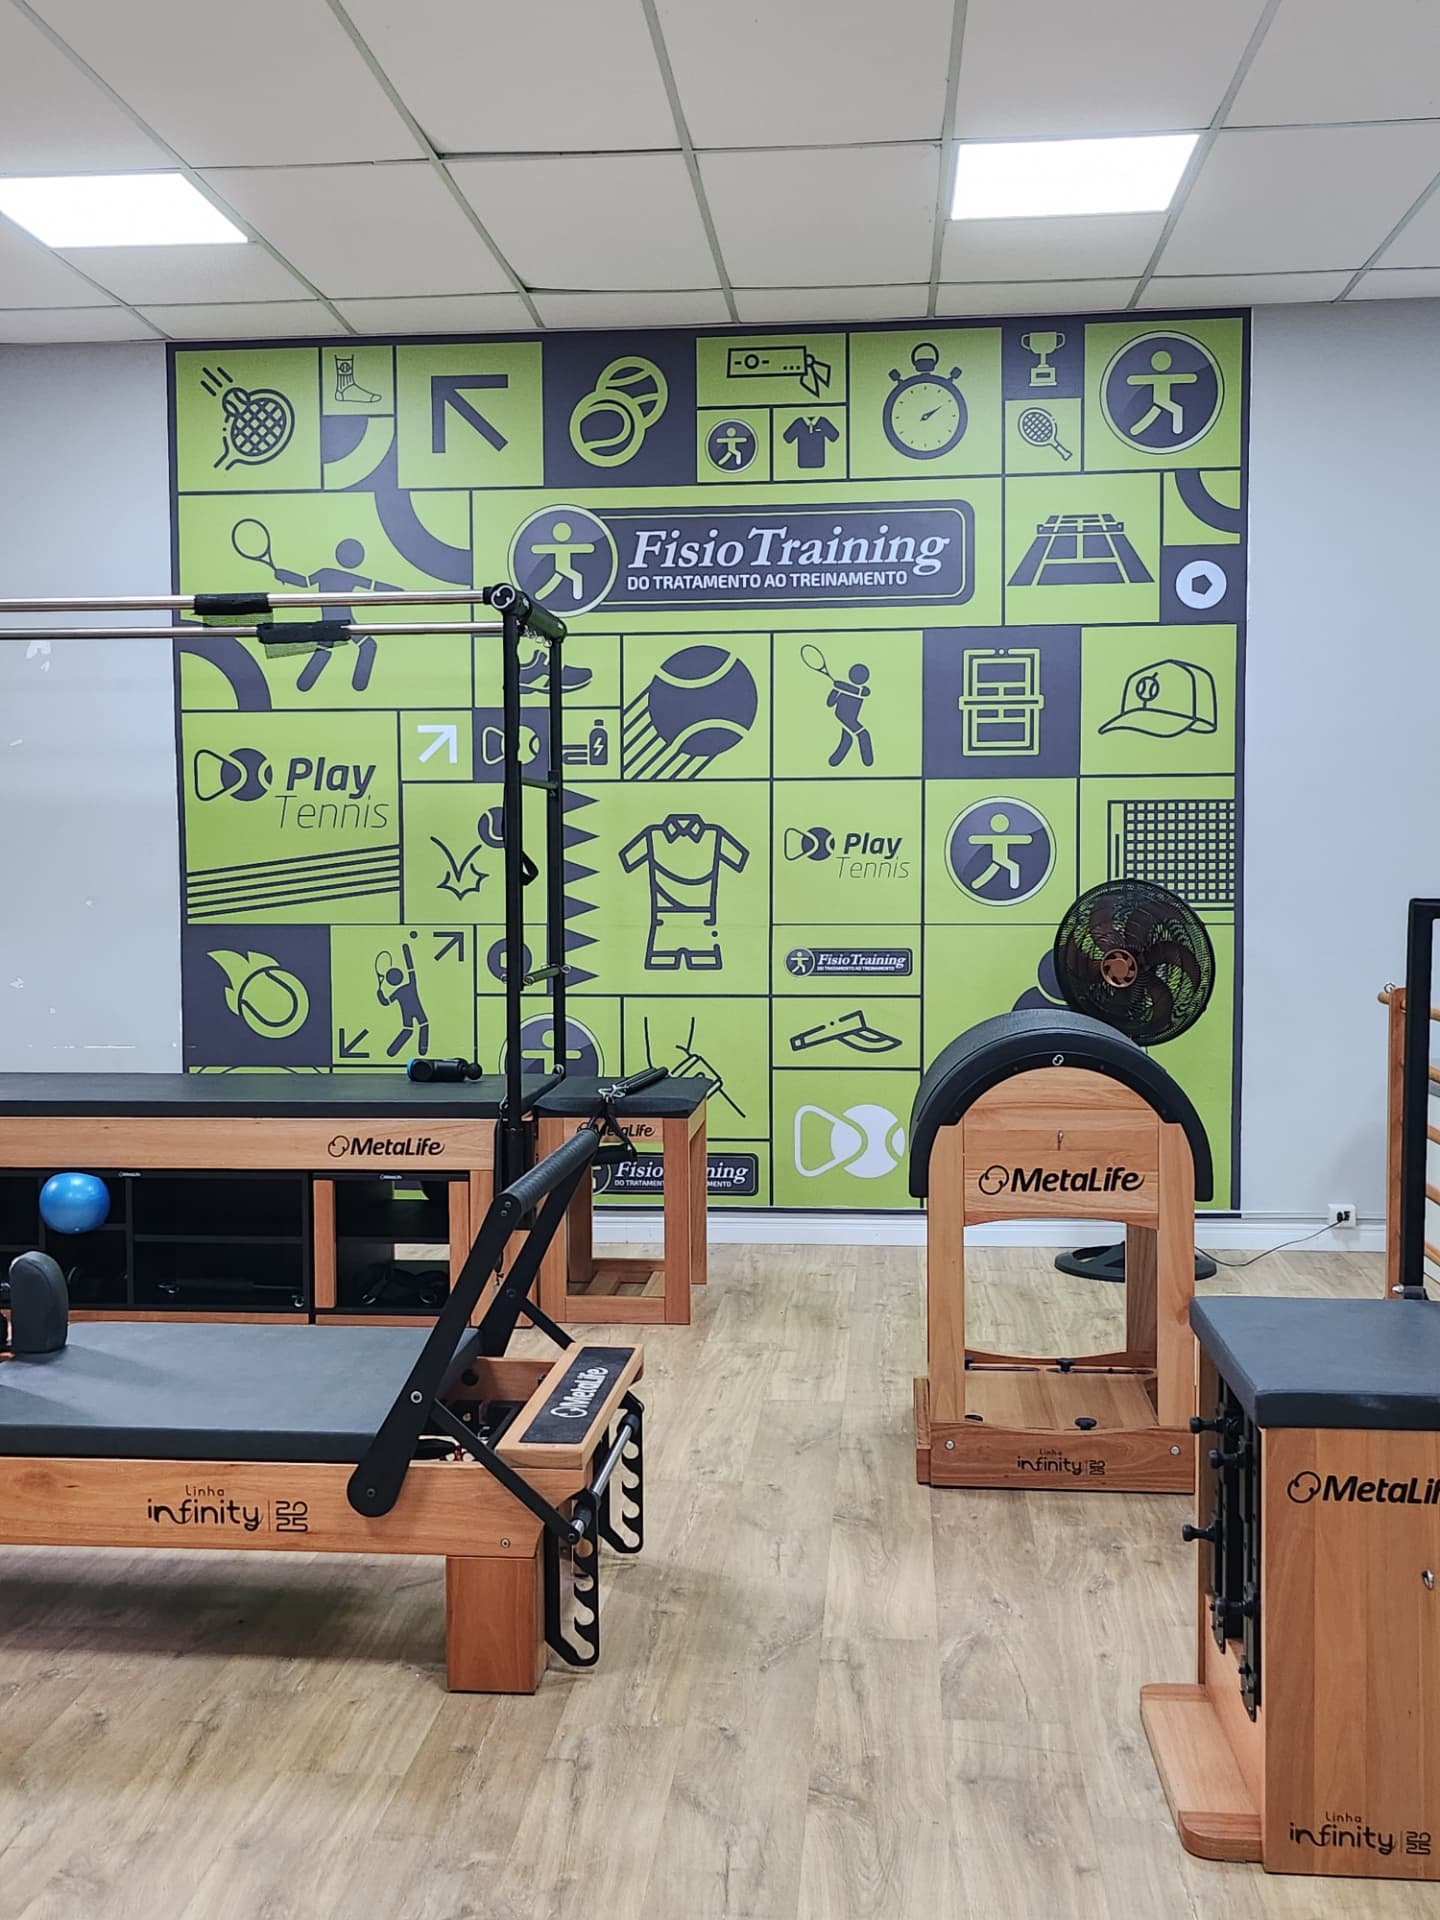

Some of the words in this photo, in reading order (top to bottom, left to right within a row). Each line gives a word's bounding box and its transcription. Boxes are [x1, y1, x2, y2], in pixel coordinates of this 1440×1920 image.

[628, 576, 649, 590] DO
[653, 573, 760, 589] TRATAMENTO
[764, 573, 786, 588] AO
[790, 570, 908, 587] TREINAMENTO
[286, 757, 376, 799] Play
[275, 795, 389, 828] Tennis
[843, 832, 903, 859] Play
[836, 856, 911, 879] Tennis
[350, 1137, 445, 1156] MetaLife
[1011, 1167, 1145, 1192] MetaLife
[559, 1366, 609, 1408] MetaLife
[1017, 1456, 1082, 1475] infinity
[148, 1498, 264, 1531] infinity
[1290, 1822, 1396, 1855] infinity
